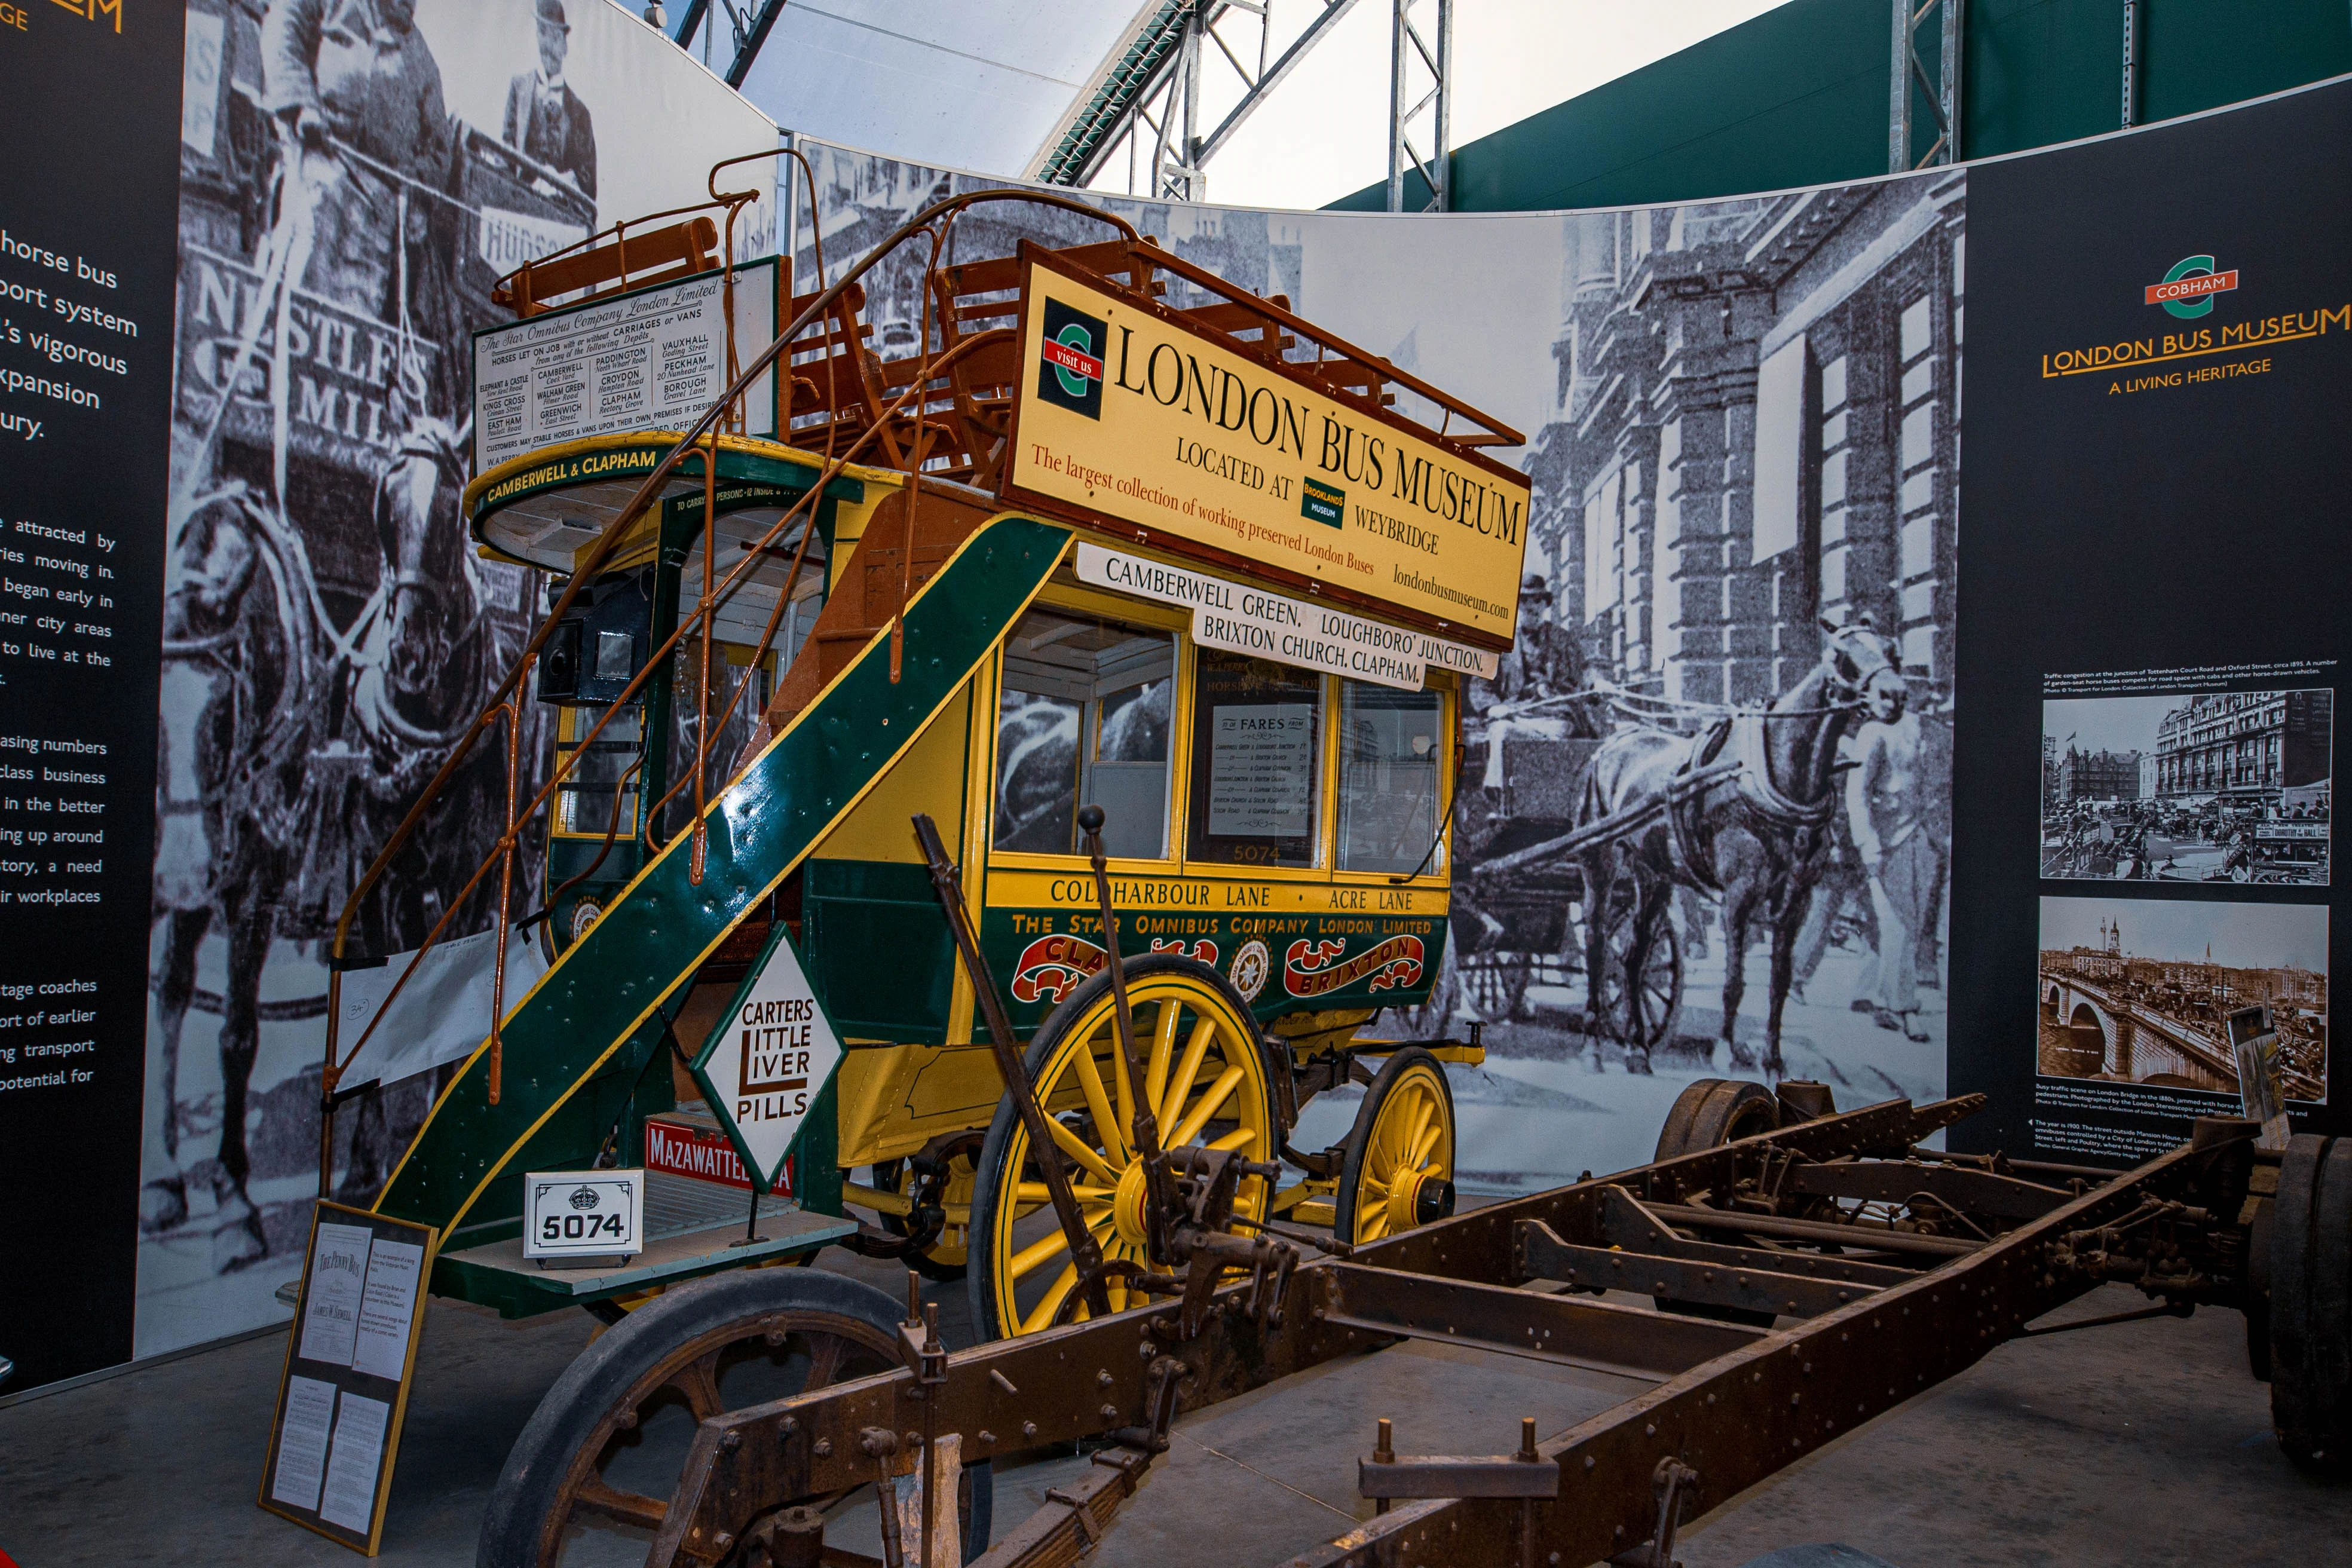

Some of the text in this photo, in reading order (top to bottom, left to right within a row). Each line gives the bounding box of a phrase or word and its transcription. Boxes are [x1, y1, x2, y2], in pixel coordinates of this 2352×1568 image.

[1, 229, 118, 289] horse bus
[2157, 275, 2226, 299] COBHAM
[54, 298, 137, 337] system
[480, 279, 718, 353] The Star Omnibus Company London Limited
[492, 308, 702, 367] HORSES LET ON JOB with or without CARRIAGES or VANS
[662, 333, 709, 351] VAUXHALL
[2042, 304, 2351, 378] LONDON BUS MUSEUM
[29, 332, 128, 375] vigorous
[596, 347, 646, 366] PADDINGTON
[664, 356, 707, 372] PECKHAM
[1056, 348, 1093, 375] visit us
[537, 362, 583, 380] CAMBERWELL
[601, 369, 640, 386] CROYDON
[2109, 359, 2271, 395] A LIVING HERITAGE
[479, 375, 529, 393] ELEPHANT CASTLE
[537, 381, 586, 400] WALHAM GREEN
[664, 376, 707, 394] BOROUGH
[482, 395, 526, 412] KINGS CROSS
[601, 390, 641, 407] CLAPHAM
[488, 416, 522, 430] EAST HAM
[540, 403, 583, 419] GREENWICH
[486, 405, 691, 453] CUSTOMERS MAY STABLE HORSES VANS UPON THEIR OWN PREMISES IF
[1114, 324, 1521, 548] LONDON BUS MUSEUM
[487, 450, 657, 504] CAMBERWELL & CLAPHAM
[1177, 437, 1440, 556] LOCATED AT WEYBRIDGE
[1303, 483, 1344, 507] BROOKLANDS
[1031, 444, 1375, 576] The largest collection of working preserved London Buses
[1312, 503, 1336, 519] MUSEUM
[16, 520, 116, 553] attracted by
[35, 555, 115, 579] moving in.
[4, 577, 113, 608] began early in
[1393, 563, 1509, 620] londonbusmuseum.com
[36, 615, 112, 638] city areas
[1105, 557, 1484, 673] CAMBERWELL GREEN. LOUGHBORO' JUNCTION.
[2, 641, 111, 667] to live at the
[1203, 615, 1420, 685] BRIXTON CHURCH. CLAPHAM.
[1241, 718, 1285, 730] FARES
[42, 738, 108, 755] numbers
[43, 767, 106, 784] business
[4, 797, 106, 813] in the better
[28, 830, 103, 846] up around
[1233, 845, 1281, 862] 5074
[17, 889, 101, 906] workplaces
[1051, 879, 1271, 907] COLHARBOUR LANE
[1328, 889, 1413, 911] ACRE LANE
[1012, 914, 1054, 934] THE
[1135, 915, 1219, 934] OMNIBUS
[1231, 916, 1309, 935] COMPANY
[1319, 918, 1375, 935] LONDON
[1382, 920, 1432, 935] LIMITED
[1298, 940, 1410, 995] BRIXTON
[39, 979, 97, 994] coaches
[27, 1009, 96, 1026] of earlier
[742, 998, 814, 1025] CARTERS
[24, 1039, 96, 1058] transport
[740, 1024, 811, 1054] LITTLE
[71, 1068, 94, 1083] for
[737, 1091, 810, 1124] PILLS
[543, 1212, 624, 1240] 5074
